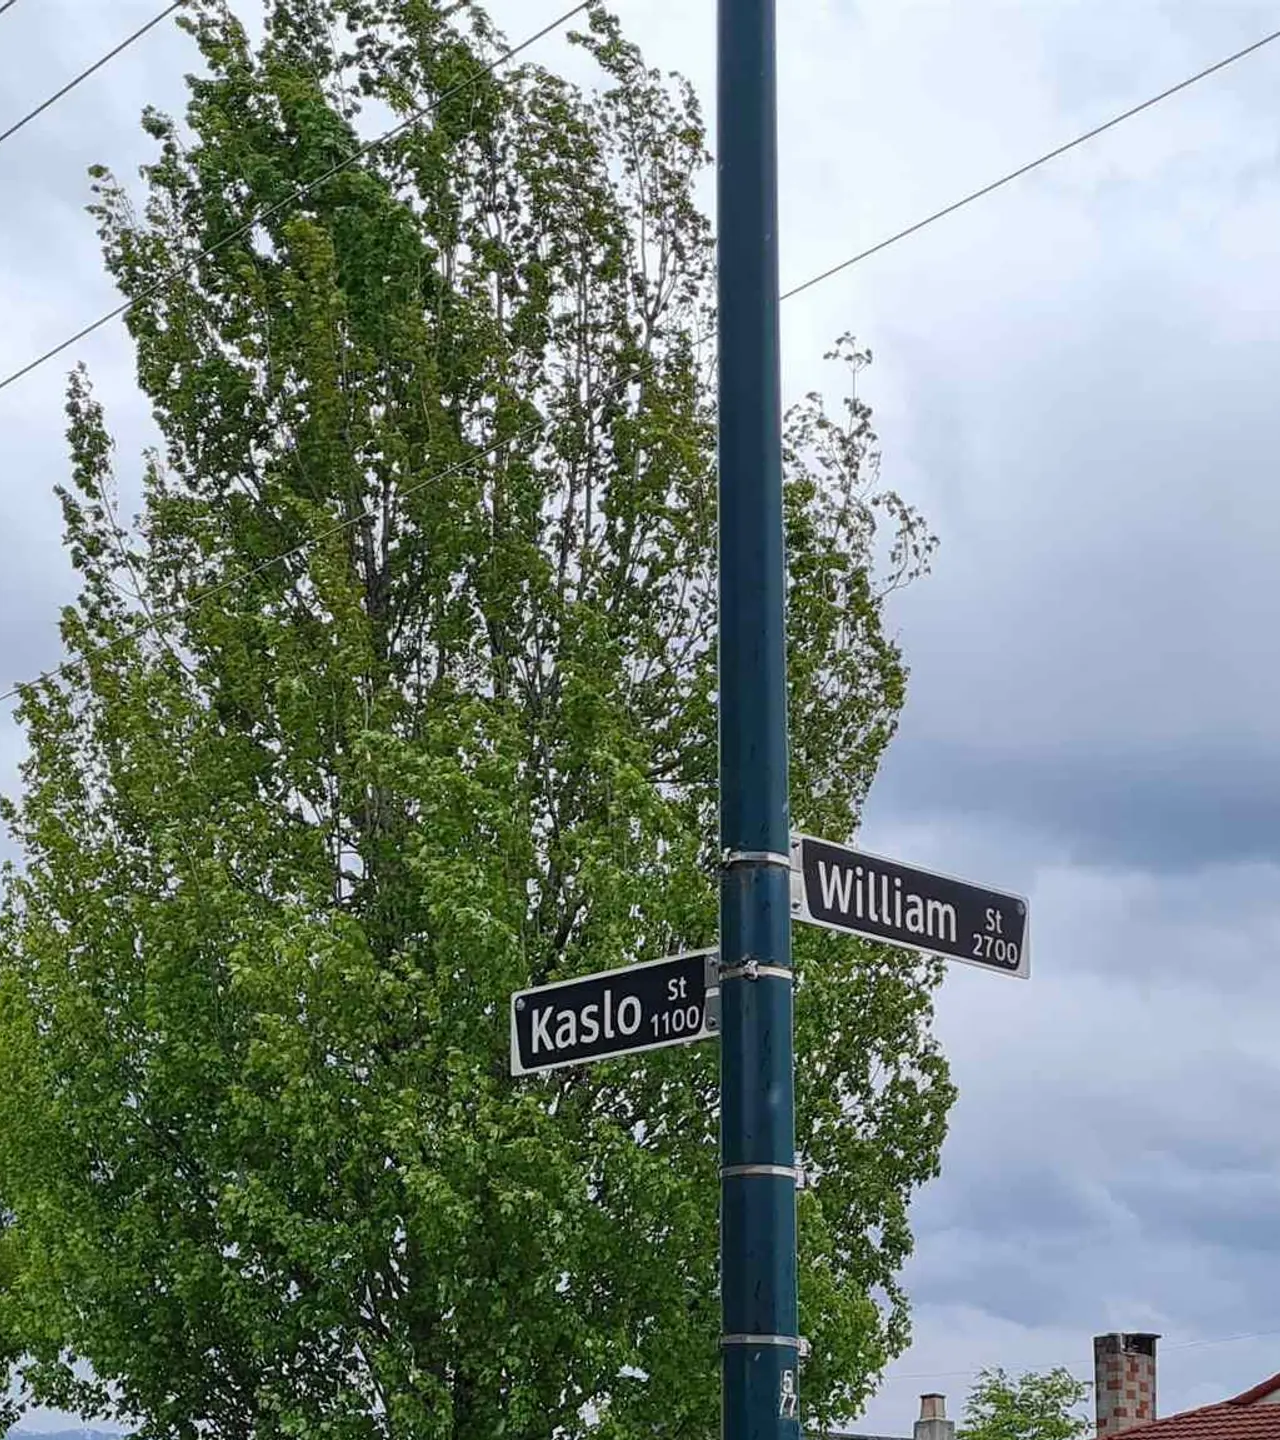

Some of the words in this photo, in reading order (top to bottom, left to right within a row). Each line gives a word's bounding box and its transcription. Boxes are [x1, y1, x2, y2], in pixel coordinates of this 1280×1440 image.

[818, 860, 957, 943] William
[985, 907, 1003, 935] St
[972, 933, 1018, 965] 2700
[531, 989, 642, 1054] Kaslo
[667, 976, 687, 1001] St
[650, 1005, 700, 1037] 1100
[780, 1392, 797, 1418] 77
